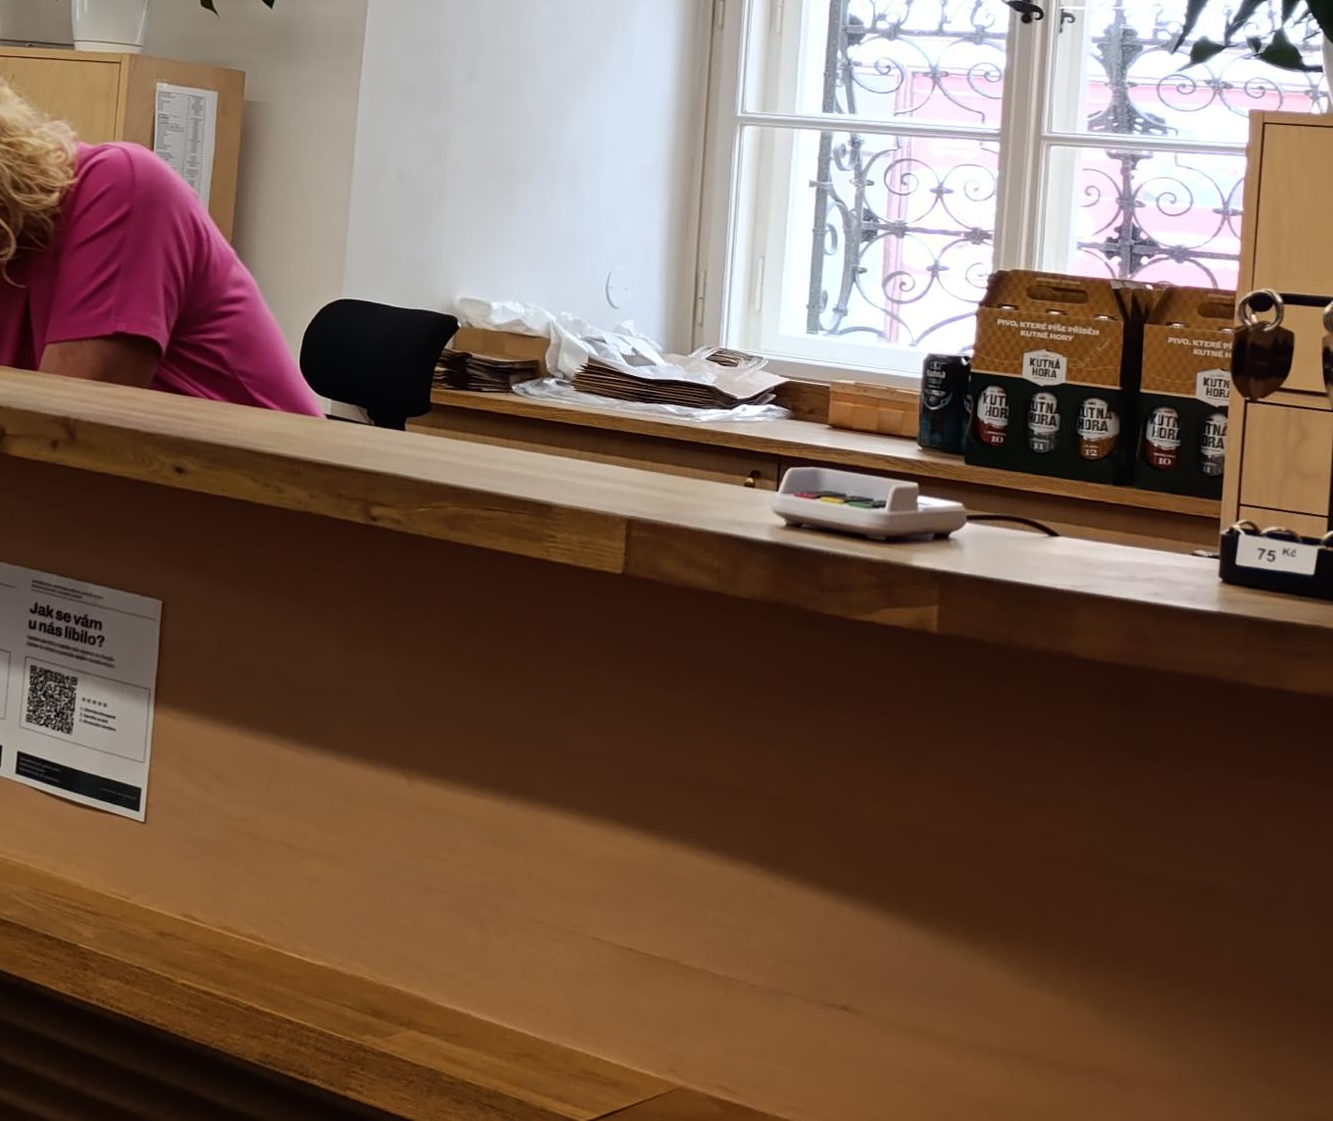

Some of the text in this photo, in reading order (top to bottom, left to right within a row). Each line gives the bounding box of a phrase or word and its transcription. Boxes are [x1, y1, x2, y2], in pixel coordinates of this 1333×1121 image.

[1020, 321, 1047, 329] KTERÉ
[1048, 323, 1067, 332] PÍŠE
[1020, 330, 1074, 341] KUTNÉ HORY
[1193, 339, 1222, 348] KTERÉ
[1030, 357, 1060, 370] KUTNÁ
[1032, 367, 1057, 378] HORA
[1203, 377, 1229, 389] KUTN
[982, 392, 1008, 406] KUT
[985, 406, 1008, 418] HOR
[990, 435, 1004, 444] 10
[1084, 447, 1098, 456] 12
[1158, 457, 1172, 466] 10
[1257, 547, 1298, 562] 75 Kč
[29, 602, 103, 631] Jak se vám
[28, 620, 106, 648] u nás líbilo?
